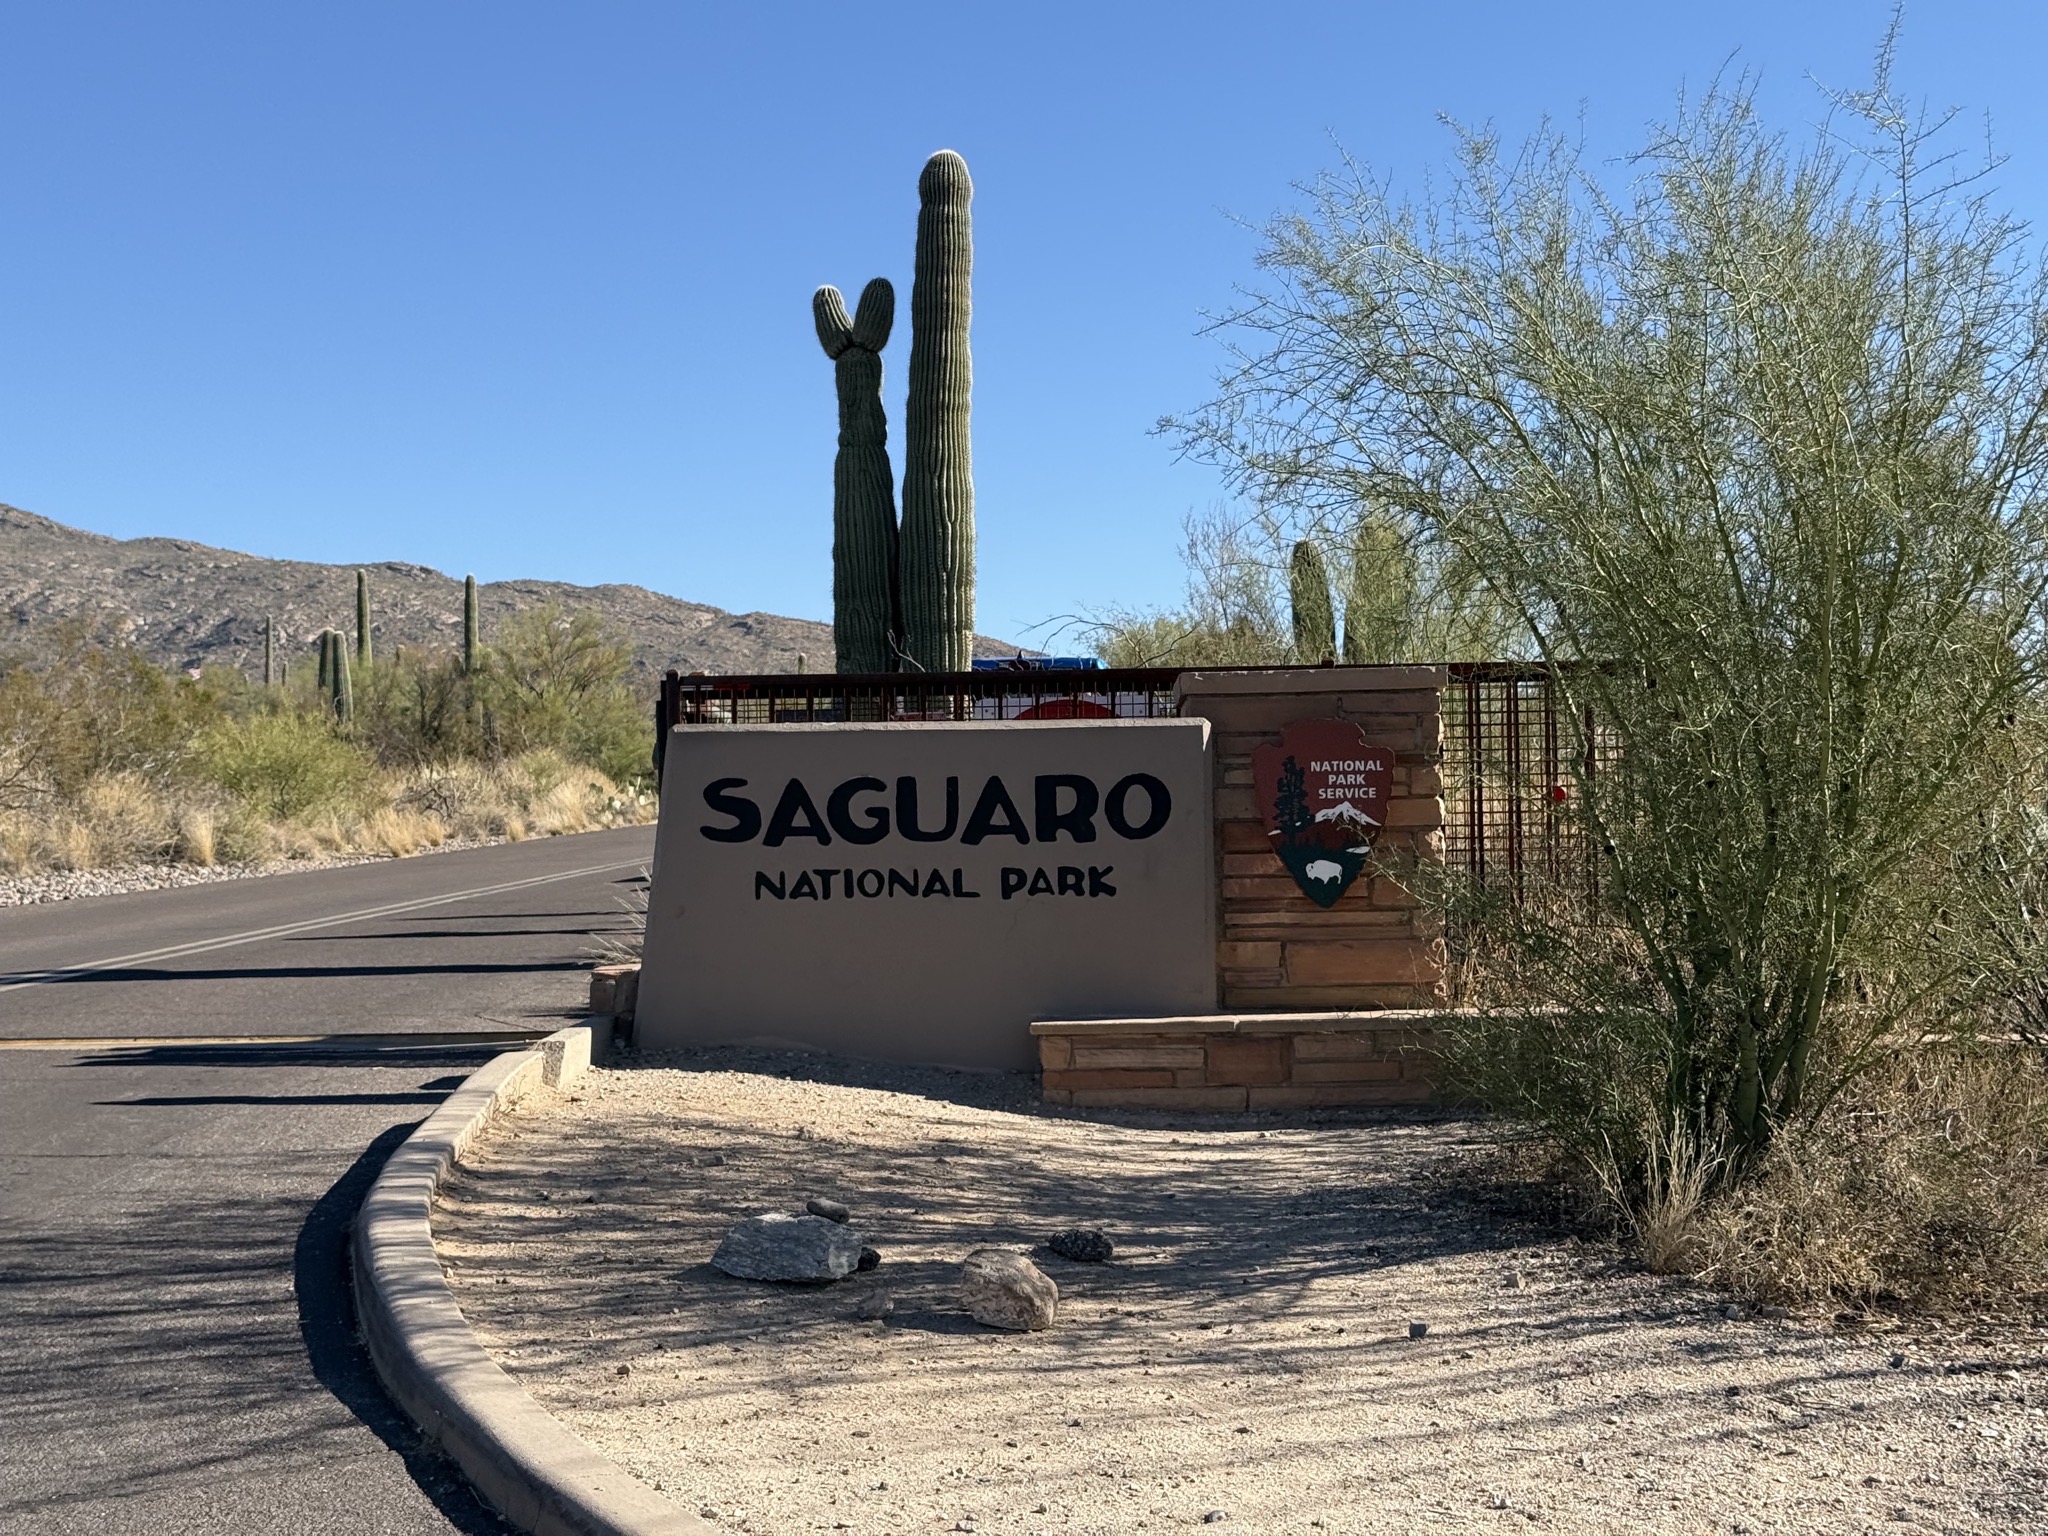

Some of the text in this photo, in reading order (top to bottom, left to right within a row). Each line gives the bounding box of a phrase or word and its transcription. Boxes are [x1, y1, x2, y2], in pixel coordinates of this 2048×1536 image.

[1310, 760, 1384, 772] NATIONAL
[1328, 774, 1365, 785] PARK
[1318, 788, 1376, 799] SERVICE
[700, 773, 1171, 847] SAGUARO
[755, 866, 1117, 901] NATIONAL PARK
